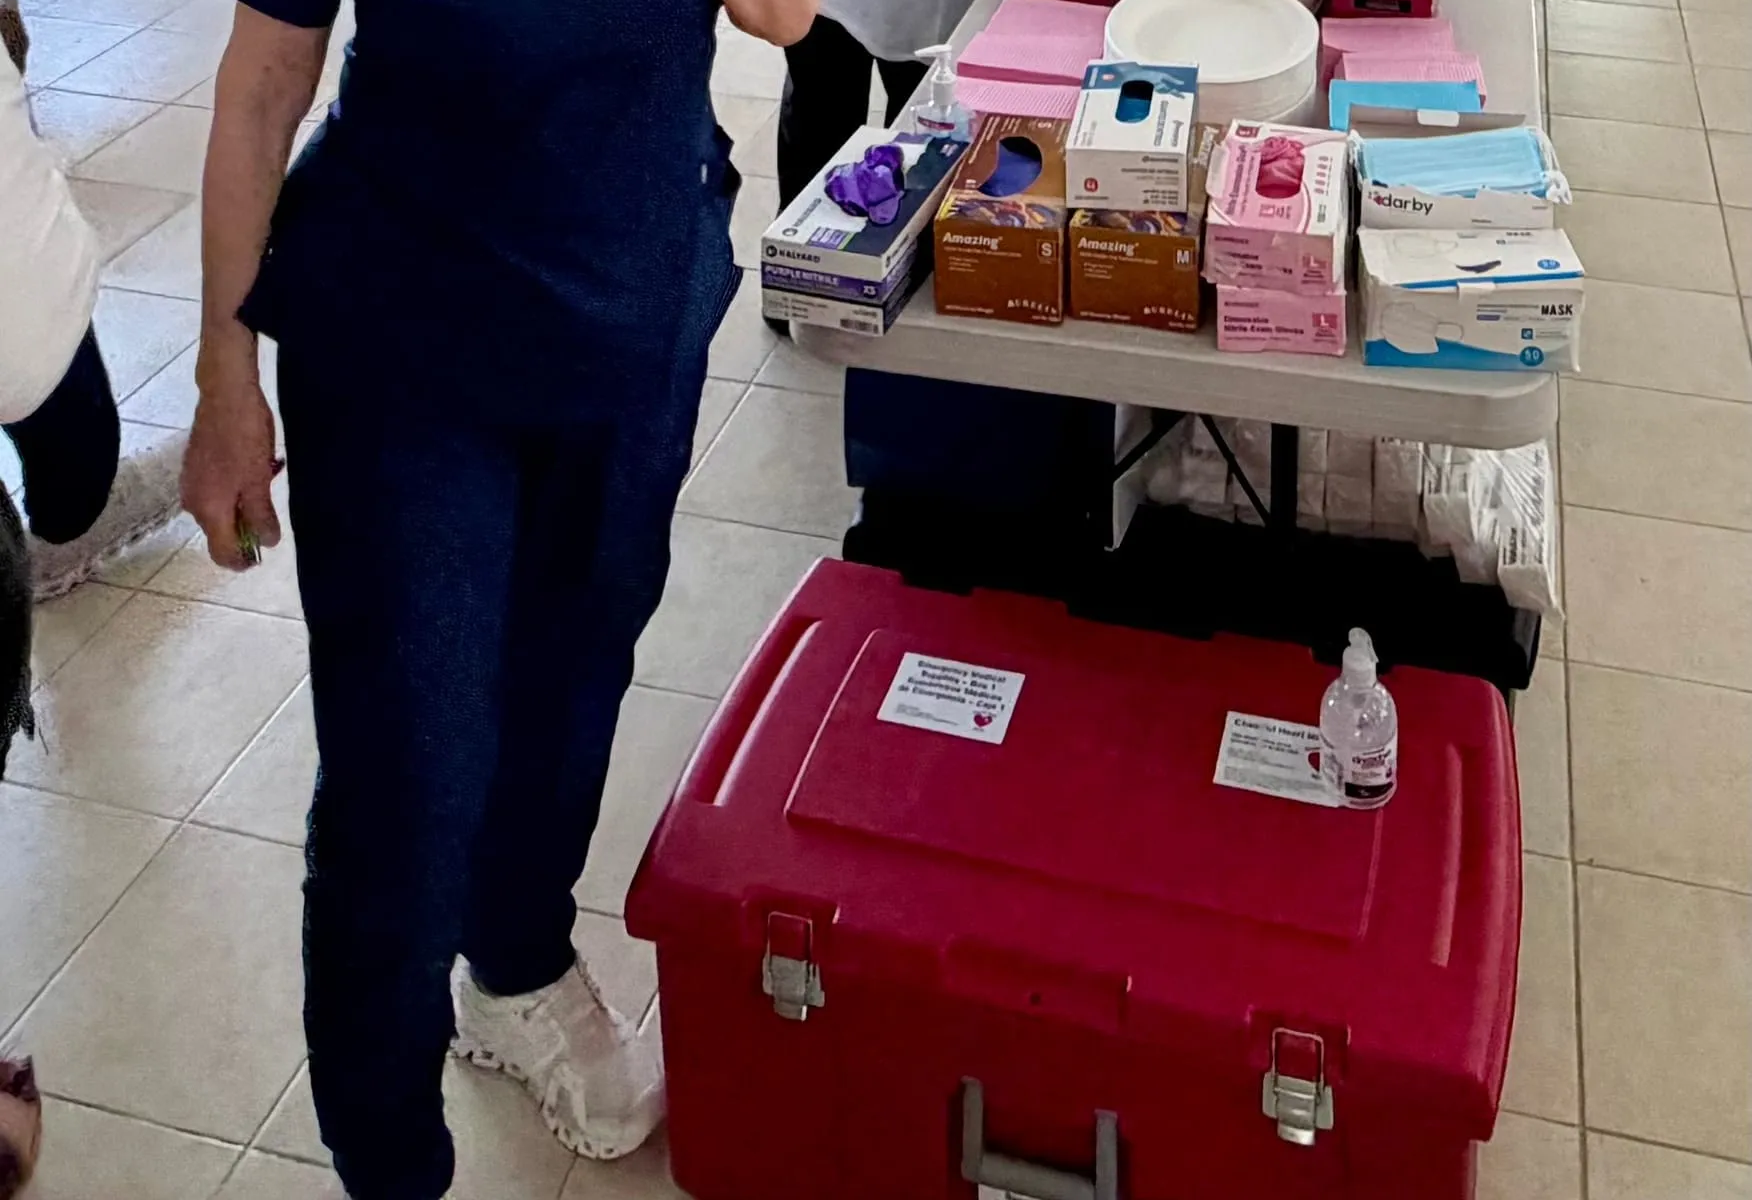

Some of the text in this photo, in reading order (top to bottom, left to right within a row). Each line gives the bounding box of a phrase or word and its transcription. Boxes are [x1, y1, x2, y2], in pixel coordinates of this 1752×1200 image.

[1382, 193, 1434, 216] darby
[943, 231, 1001, 250] Amazing
[1078, 237, 1137, 257] Amazing
[1041, 242, 1053, 257] S
[1176, 249, 1190, 264] M
[1541, 303, 1574, 316] MASK
[1320, 313, 1330, 328] L
